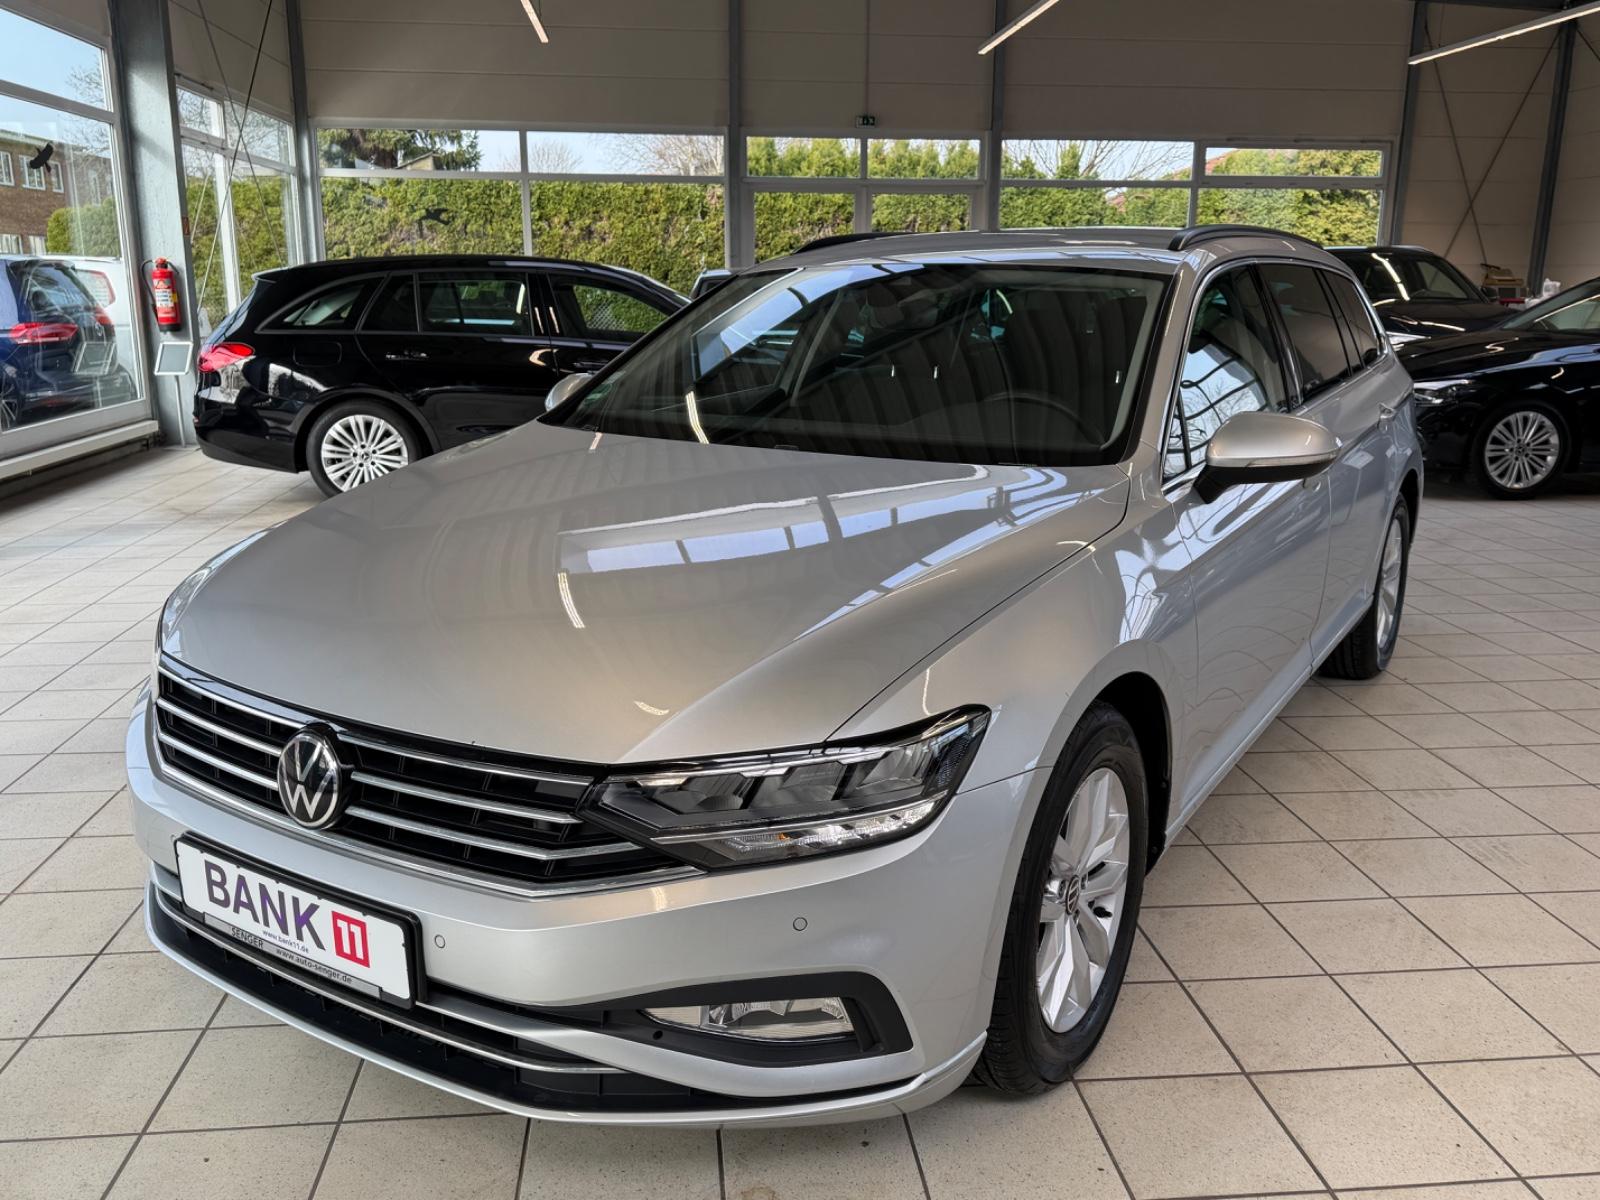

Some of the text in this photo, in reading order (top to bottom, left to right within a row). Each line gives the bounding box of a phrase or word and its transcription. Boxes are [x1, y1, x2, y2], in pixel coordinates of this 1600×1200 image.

[204, 860, 365, 962] BANK 11
[231, 926, 264, 949] SENGER
[262, 929, 309, 954] www.bank11.de
[276, 948, 353, 984] www.auto-senger.de
